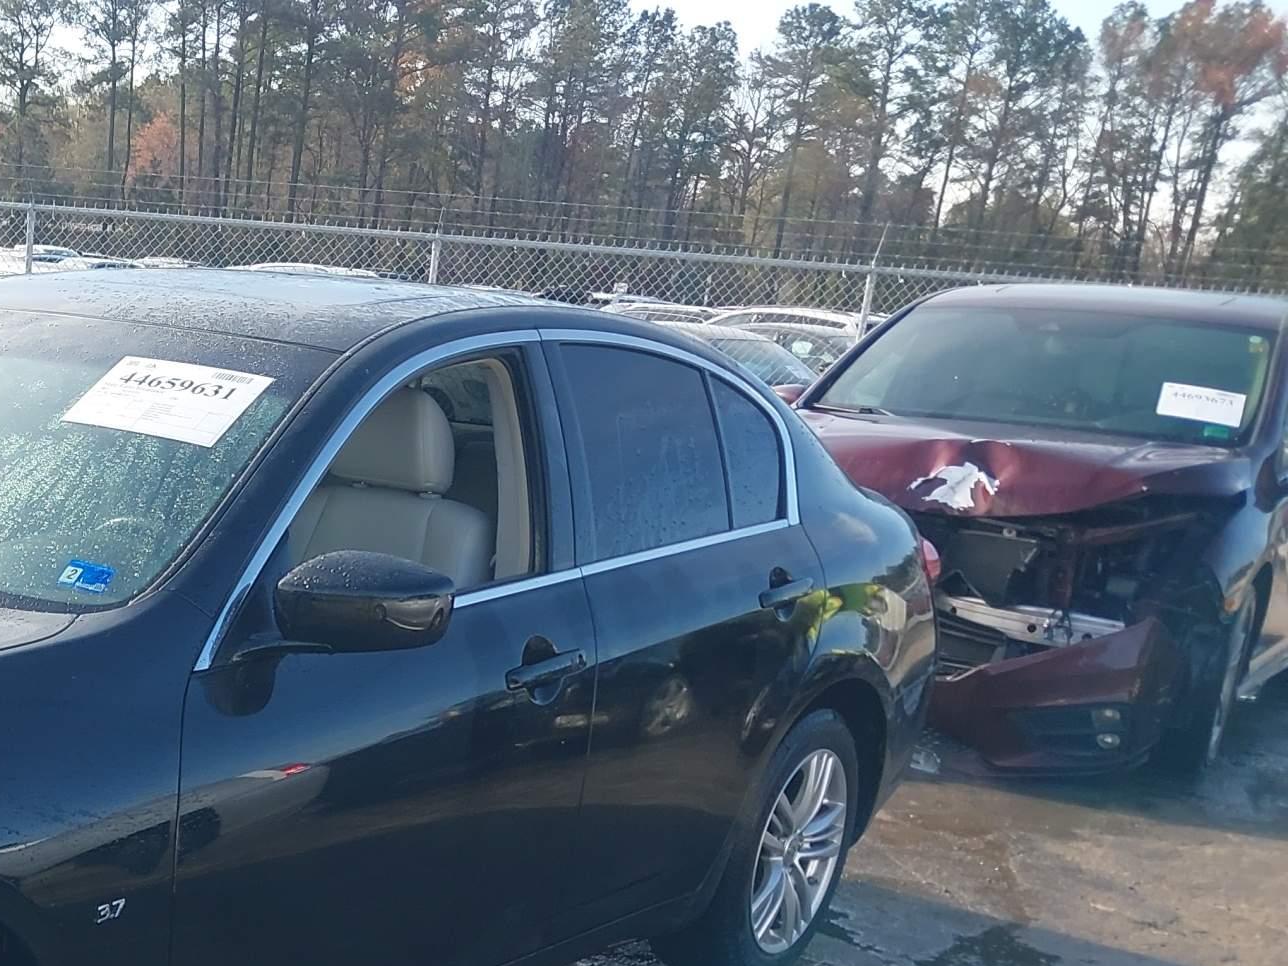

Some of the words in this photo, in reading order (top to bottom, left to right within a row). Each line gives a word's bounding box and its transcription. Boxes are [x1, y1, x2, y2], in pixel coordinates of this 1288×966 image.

[120, 372, 237, 400] 44659631
[67, 569, 79, 580] 2
[97, 898, 126, 924] 3.7
